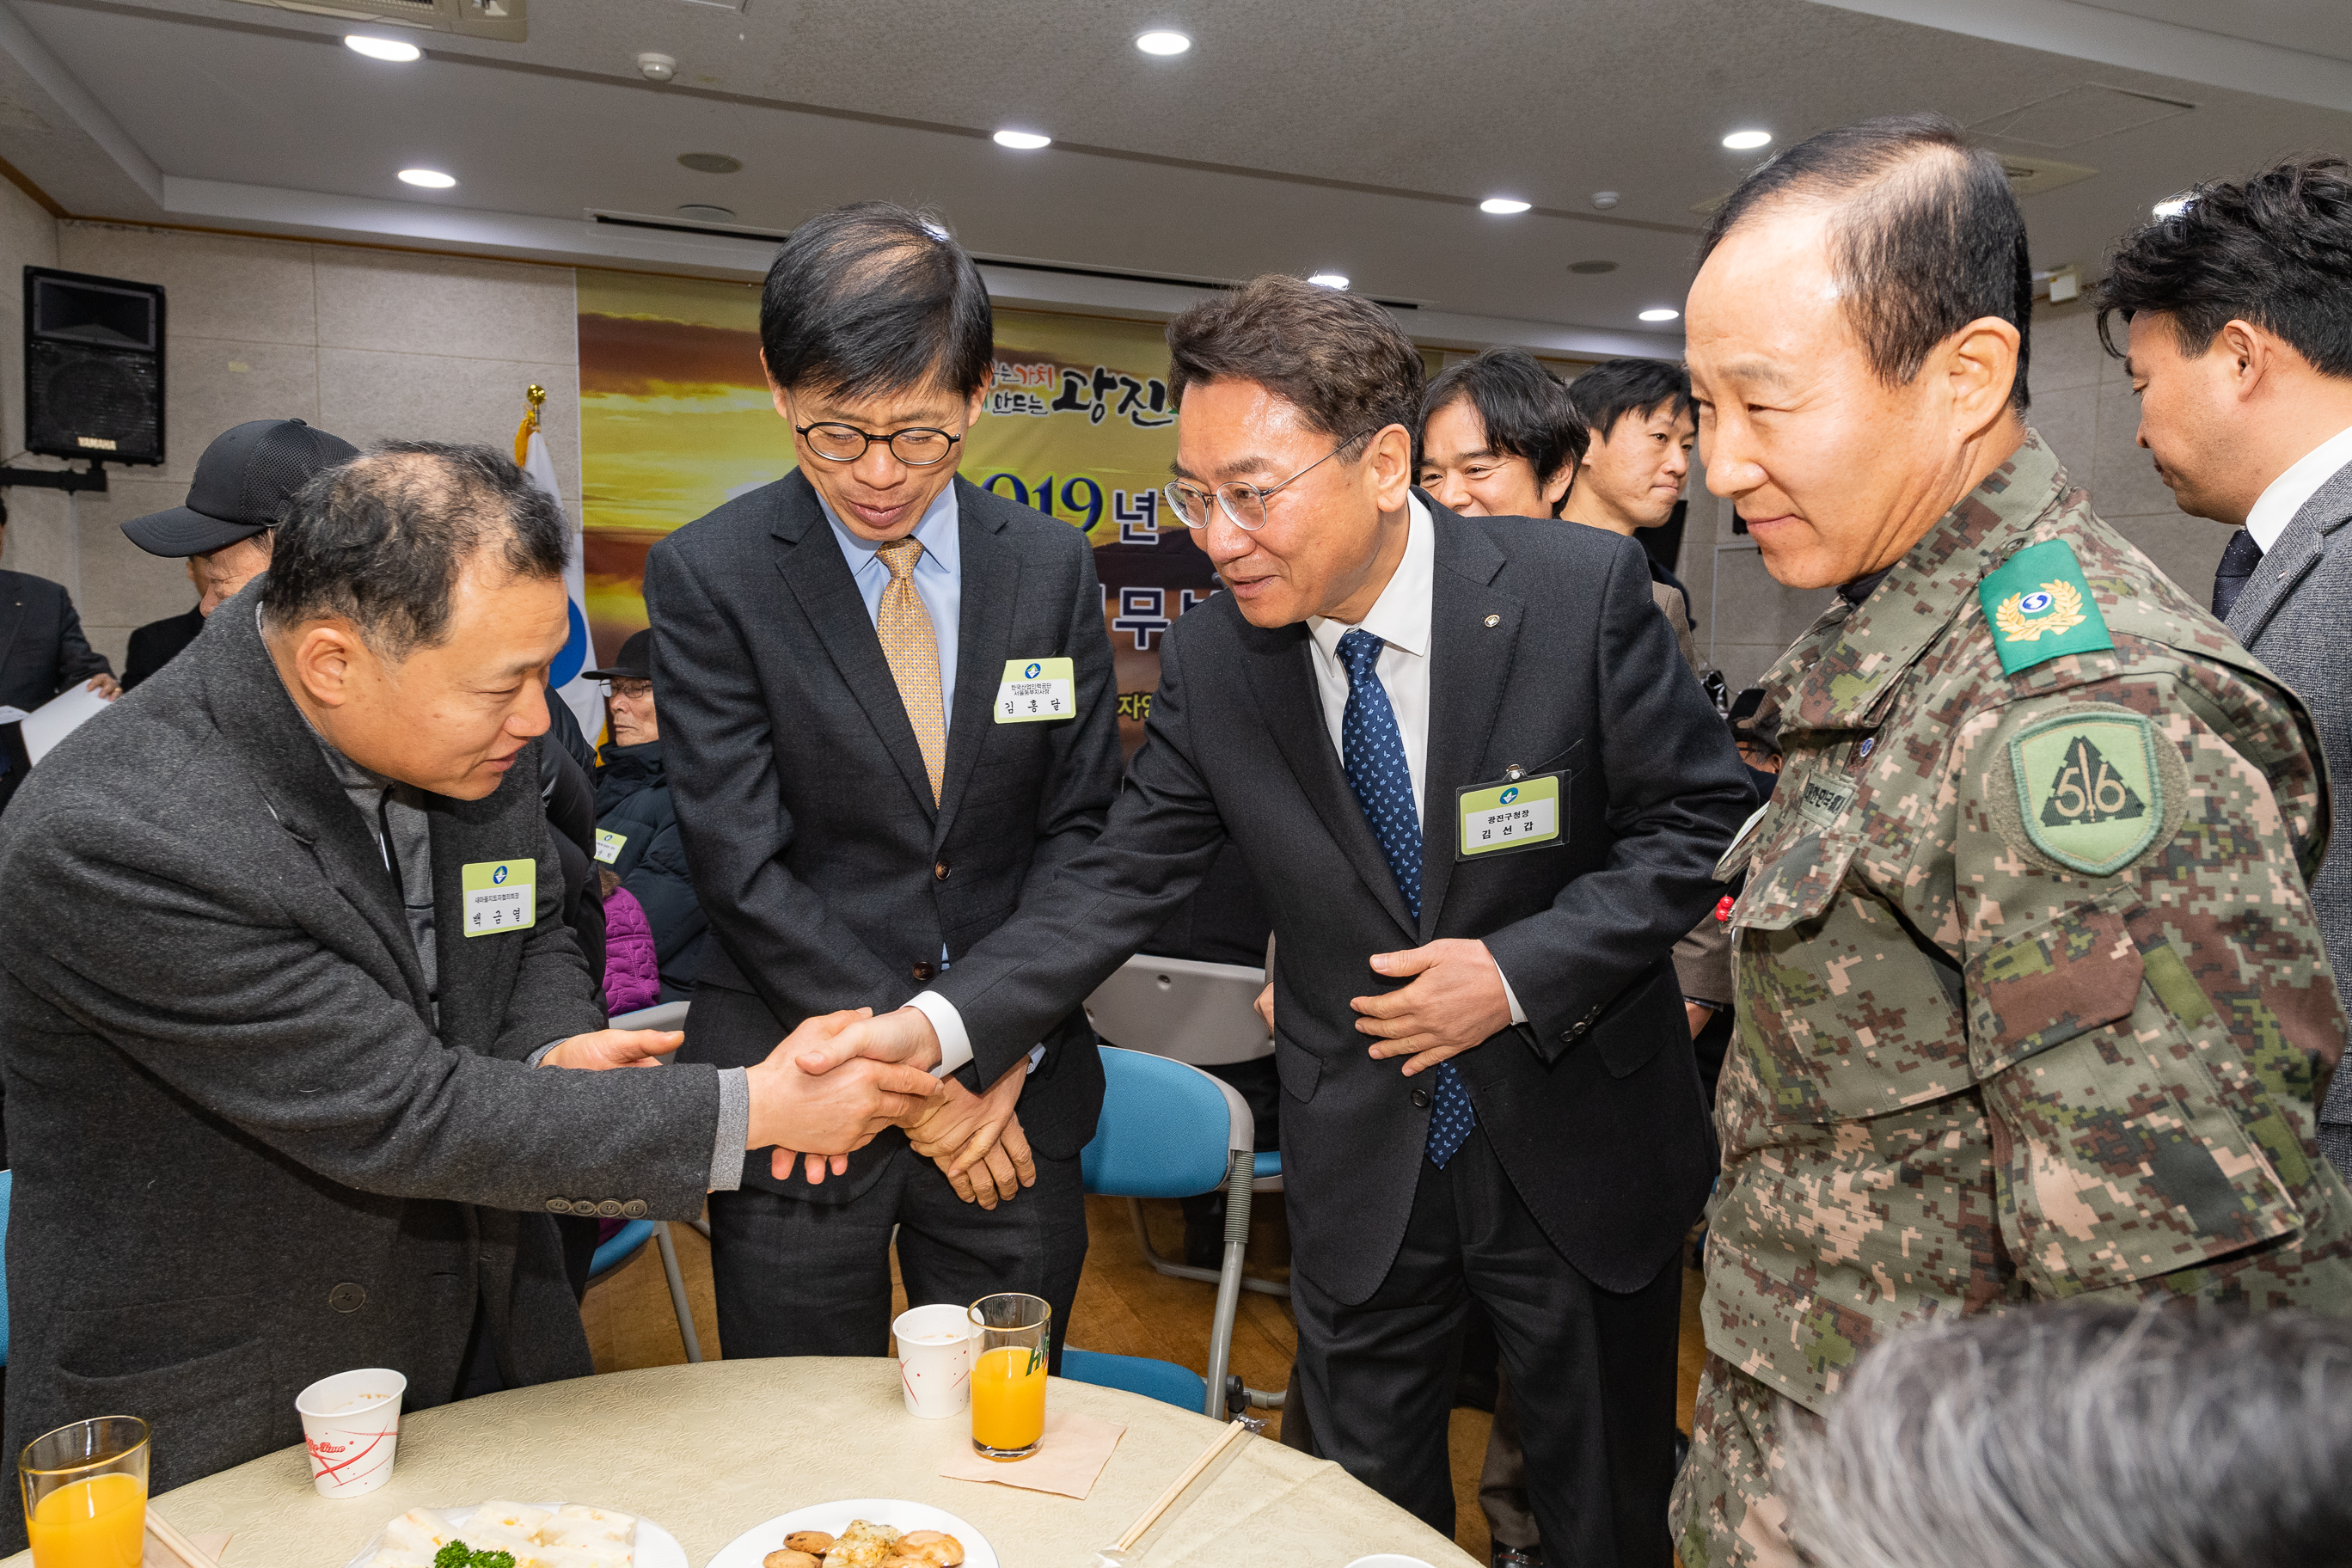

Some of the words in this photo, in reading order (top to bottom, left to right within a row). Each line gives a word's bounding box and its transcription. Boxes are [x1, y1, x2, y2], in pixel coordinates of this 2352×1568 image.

[1015, 365, 1052, 389] 가치
[993, 391, 1048, 414] 만드는
[1051, 367, 1173, 426] 광진
[77, 436, 116, 450] YAMAHA
[1487, 809, 1529, 824] 광진구청장
